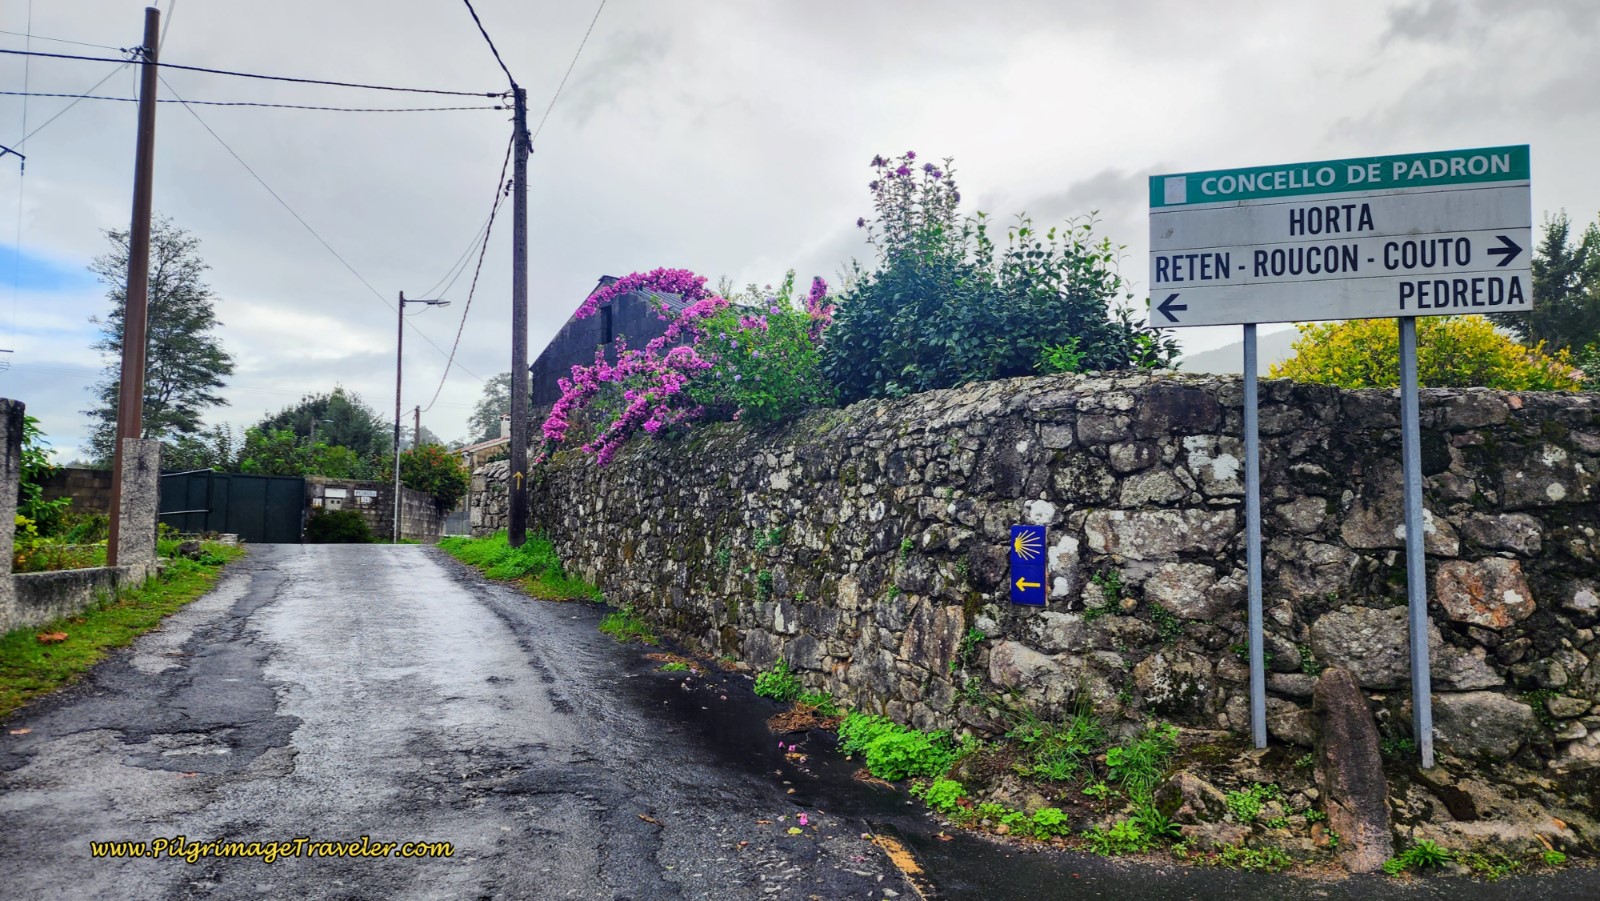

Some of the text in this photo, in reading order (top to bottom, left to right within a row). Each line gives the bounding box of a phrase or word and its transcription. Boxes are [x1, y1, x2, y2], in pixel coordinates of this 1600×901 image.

[1201, 154, 1510, 196] CONCELLO DE PADRON
[1290, 203, 1374, 236] HORTA
[1156, 252, 1230, 283] RETEN
[1254, 244, 1358, 278] ROUCON
[1384, 237, 1471, 270] COUTO
[1400, 276, 1524, 310] PEDREDA
